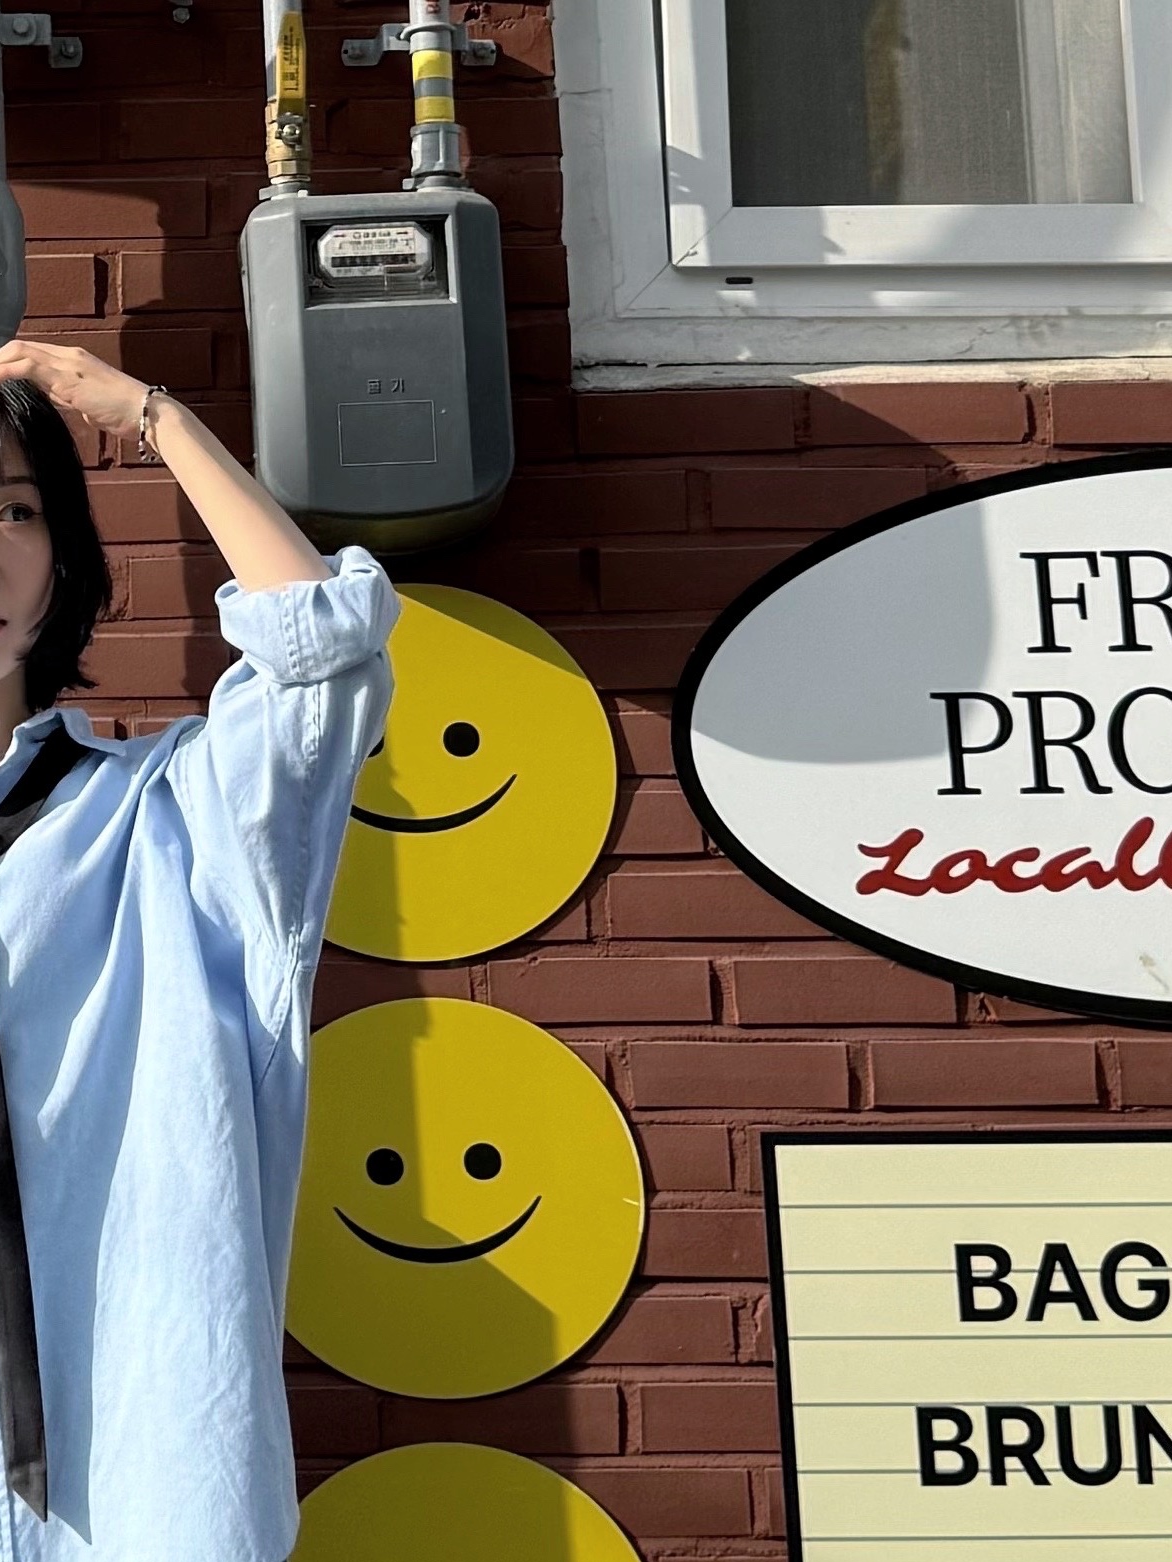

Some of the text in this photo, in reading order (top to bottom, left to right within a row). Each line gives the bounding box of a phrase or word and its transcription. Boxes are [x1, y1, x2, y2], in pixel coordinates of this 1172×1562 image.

[1019, 550, 1172, 654] FR
[929, 686, 1172, 796] PRO
[953, 1240, 1171, 1323] BAG
